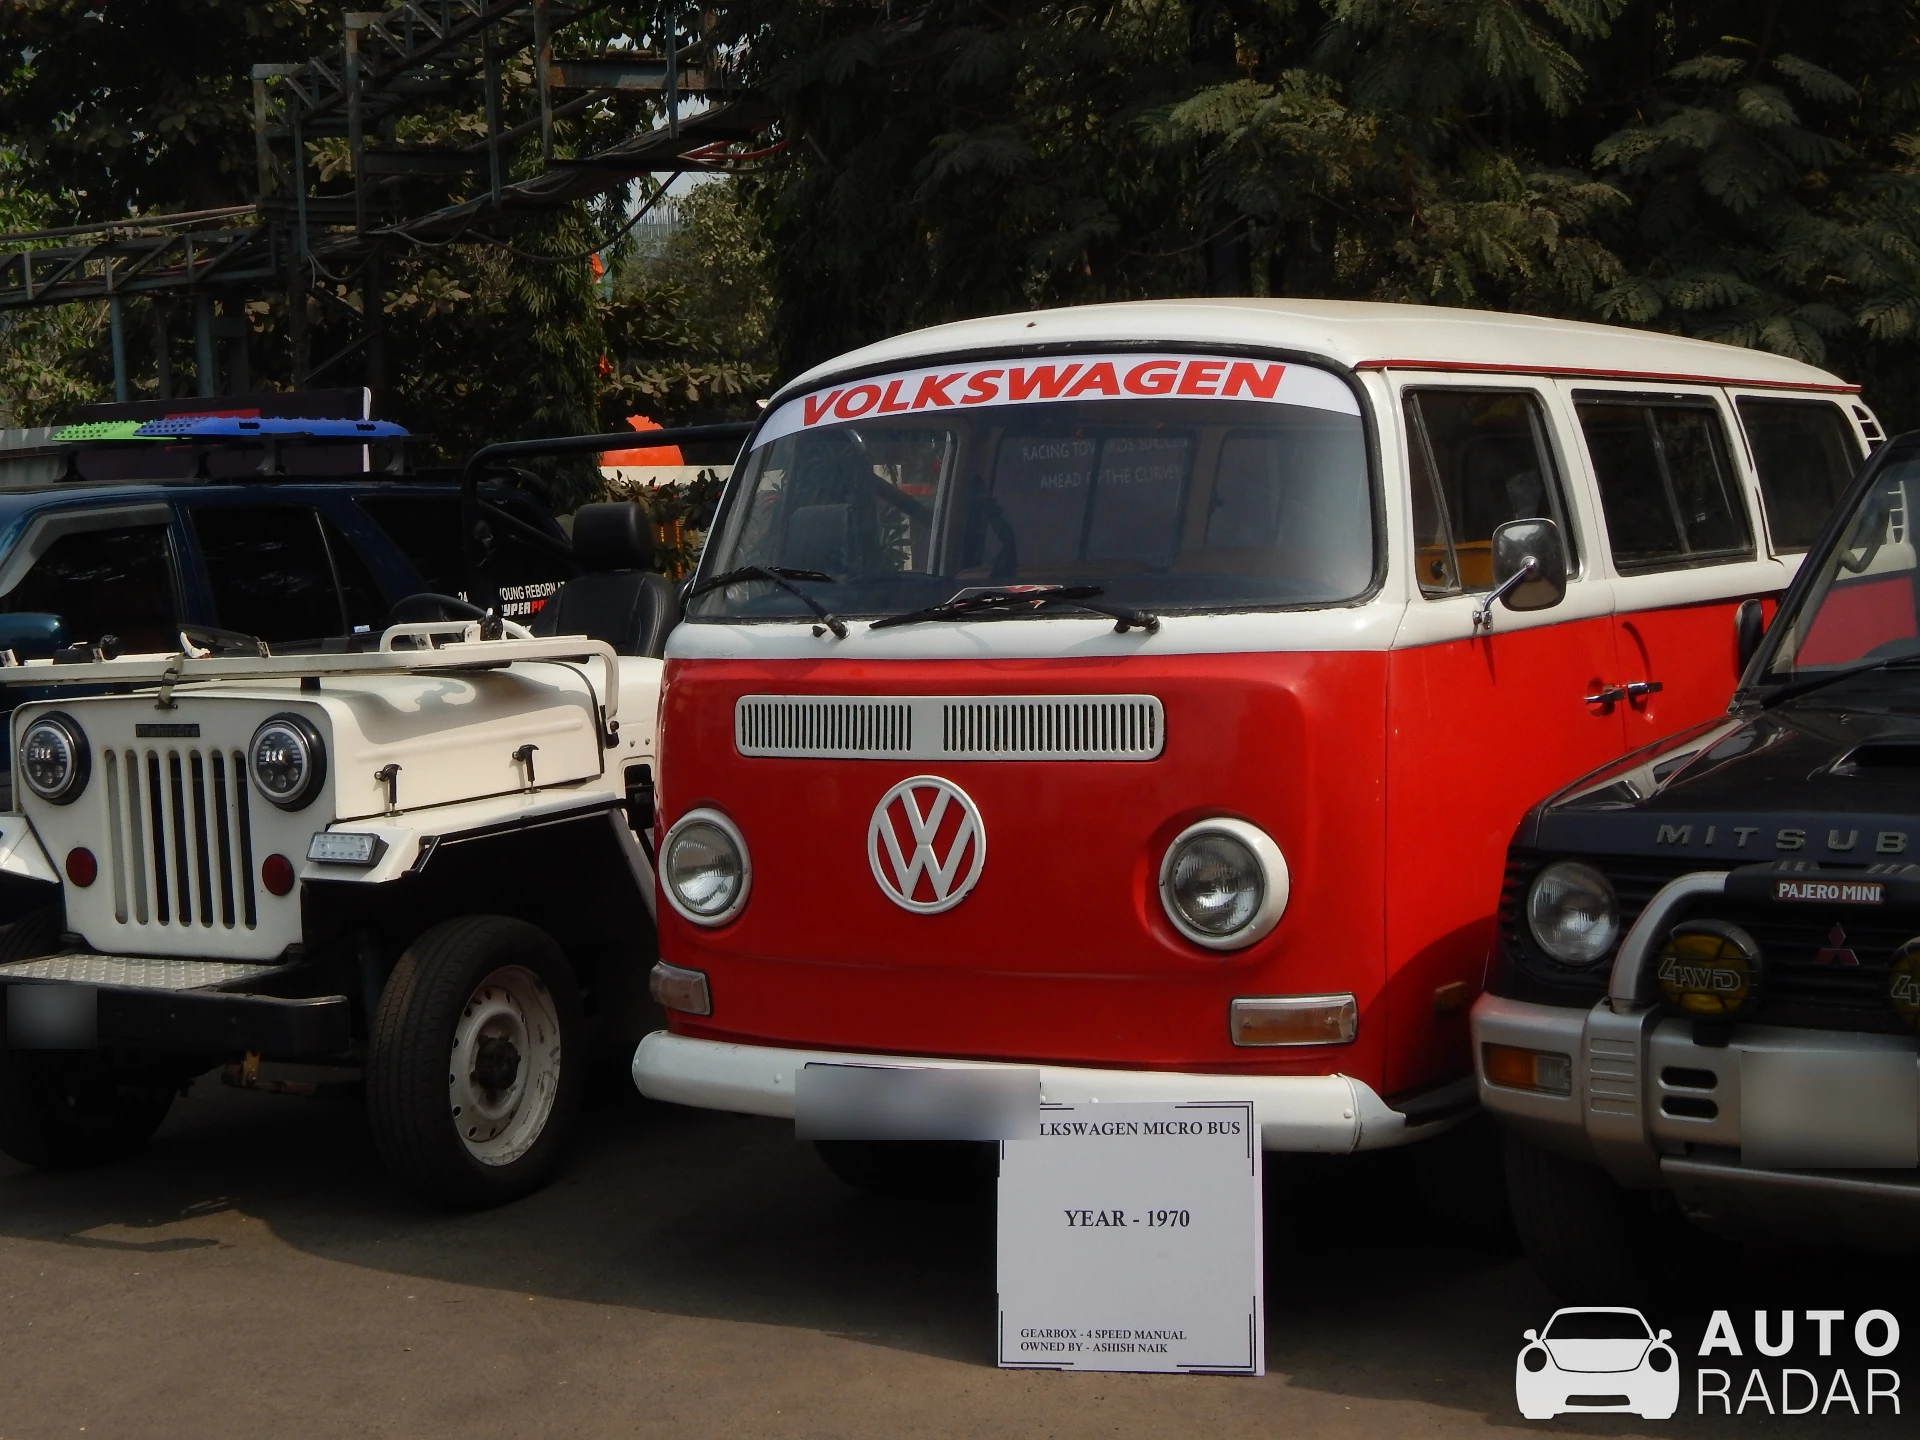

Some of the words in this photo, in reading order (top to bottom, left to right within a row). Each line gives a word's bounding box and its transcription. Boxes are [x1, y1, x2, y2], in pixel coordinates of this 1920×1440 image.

[803, 360, 1286, 426] VOLKSWAGEN
[1022, 443, 1069, 461] RACING
[1040, 471, 1082, 490] AHEAD
[1105, 467, 1131, 485] THE
[524, 582, 556, 599] REBORN
[1656, 823, 1908, 853] MITSUB
[1777, 882, 1839, 900] PAJERO
[1841, 884, 1882, 902] MINI
[1657, 957, 1741, 992] 4WD
[1040, 1121, 1138, 1137] LKSWAGEN
[1143, 1120, 1203, 1136] MICRO
[1207, 1120, 1241, 1136] BUS
[1063, 1208, 1128, 1228] YEAR
[1146, 1208, 1190, 1228] 1970
[1020, 1328, 1077, 1340] GEARBOX
[1086, 1329, 1093, 1340] 4
[1095, 1329, 1131, 1340] SPEED
[1134, 1329, 1187, 1341] MANUAL
[1020, 1342, 1065, 1352] OWNED
[1067, 1342, 1083, 1353] BY
[1093, 1342, 1135, 1353] ASHISH
[1138, 1342, 1169, 1354] NAIK
